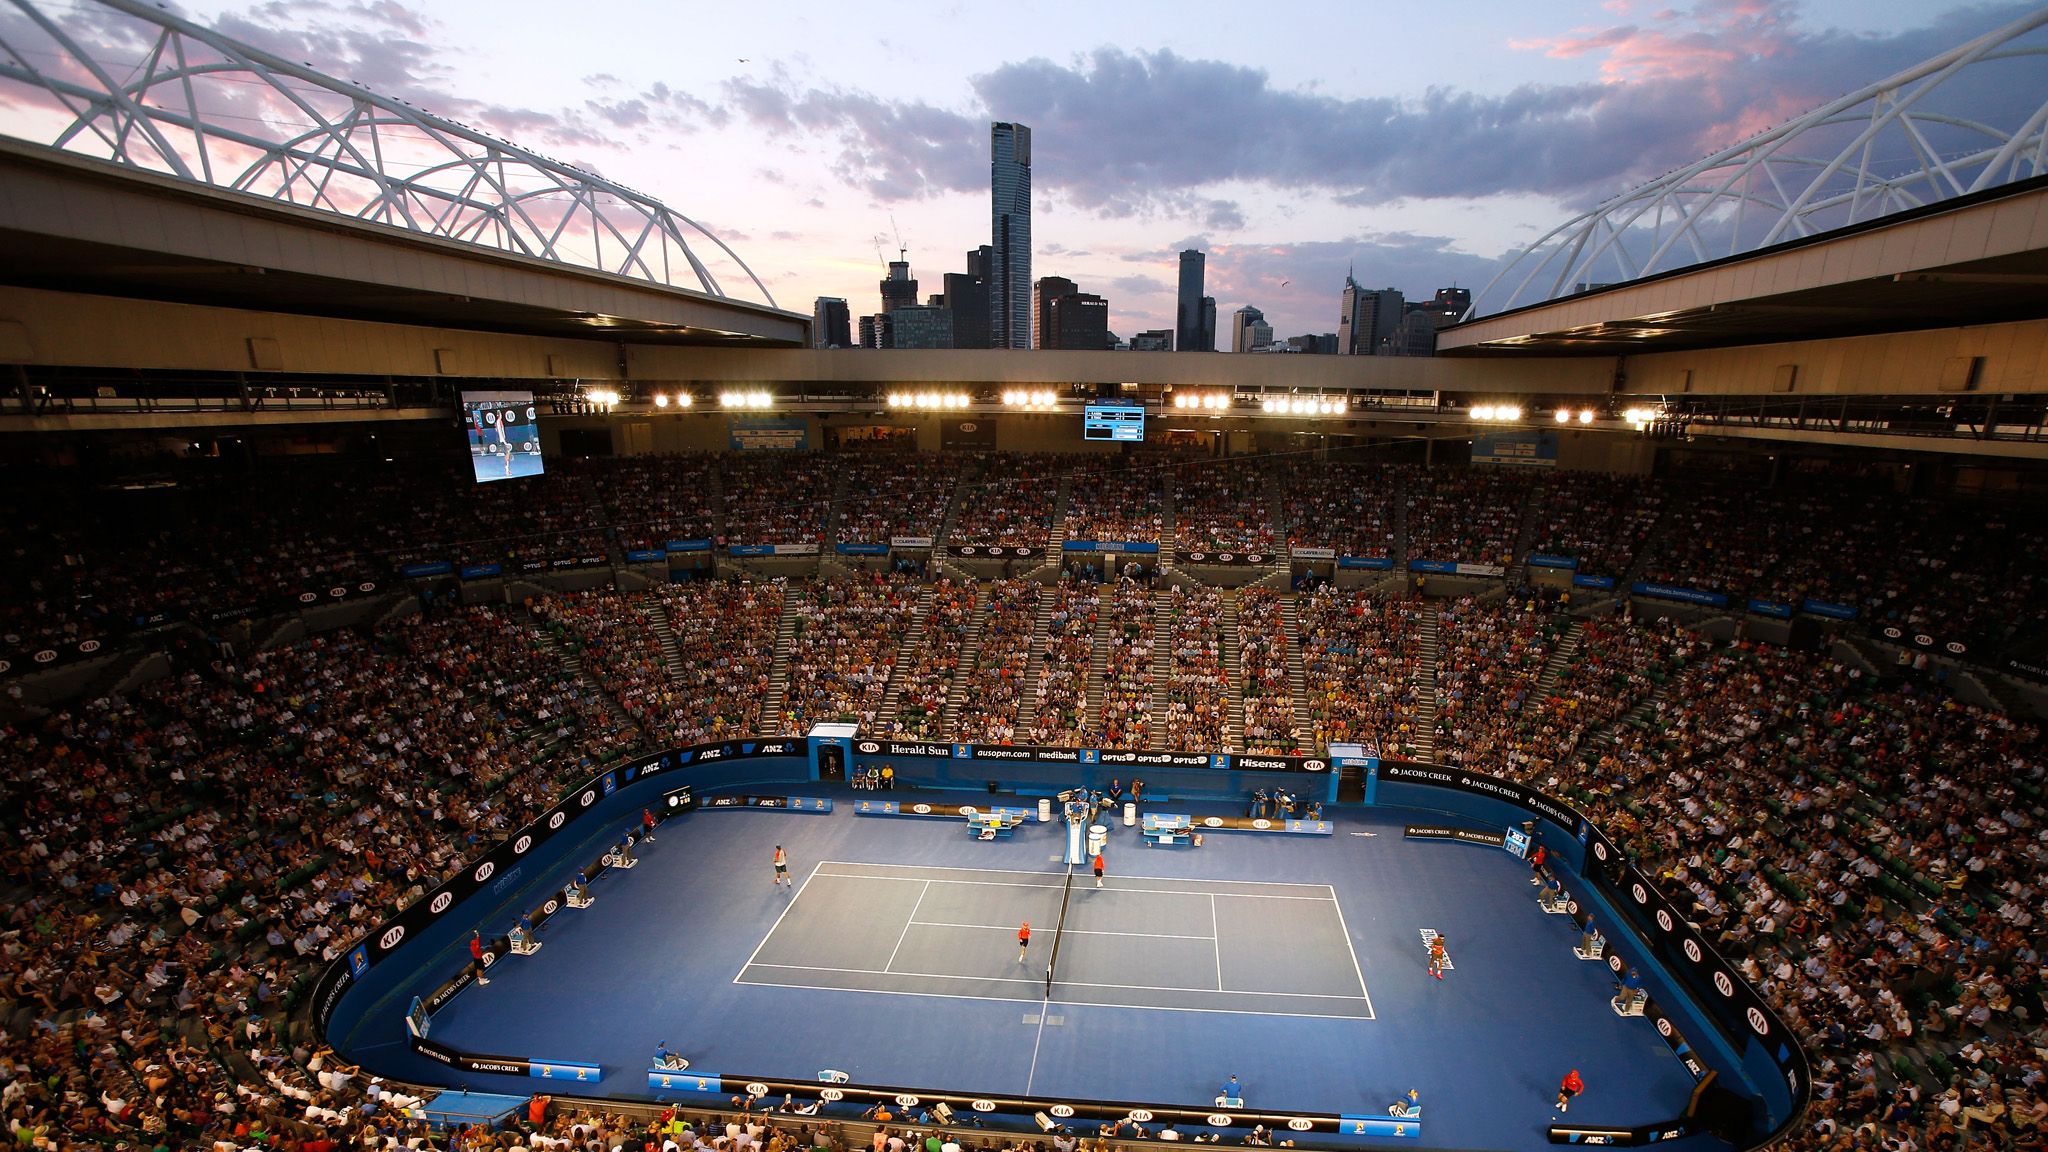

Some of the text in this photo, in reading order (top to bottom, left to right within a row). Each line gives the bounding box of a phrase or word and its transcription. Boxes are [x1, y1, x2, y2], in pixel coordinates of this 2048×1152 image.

[80, 641, 98, 651] KIA
[1916, 636, 1931, 644] KIA
[1948, 643, 1964, 652] KIA
[36, 651, 56, 661] KIA
[699, 749, 721, 760] ANZ
[762, 745, 783, 753] ANZ
[891, 744, 949, 755] Herald Sun
[977, 750, 1030, 758] ausopen.com
[1039, 751, 1077, 760] medibank
[641, 762, 660, 775] ANZ
[1239, 759, 1286, 769] Hisense
[1399, 768, 1452, 782] JACOB'S CREEK
[1470, 780, 1521, 800] JACOB'S CREEK
[582, 792, 594, 805] KIA
[551, 813, 563, 827] KIA
[1557, 812, 1574, 826] CREEK
[1511, 831, 1524, 842] 202
[516, 837, 530, 852] KIA
[1506, 842, 1522, 857] IBM
[1595, 843, 1605, 859] KIA
[602, 854, 612, 866] KIA
[477, 863, 492, 880] KIA
[1634, 885, 1645, 902] KIA
[432, 893, 450, 912] KIA
[544, 901, 556, 913] KIA
[1567, 902, 1576, 914] KIA
[1658, 911, 1670, 930] KIA
[382, 927, 403, 948] KIA
[1685, 940, 1699, 961] KIA
[482, 954, 494, 966] IA
[1610, 956, 1620, 970] KIA
[456, 973, 470, 987] CREEK
[1715, 972, 1731, 995] KIA
[1748, 1008, 1766, 1033] KIA
[1658, 1019, 1670, 1035] KIA
[1686, 1058, 1701, 1076] ANZ
[748, 1084, 767, 1093] KIA
[822, 1090, 841, 1099] KIA
[897, 1096, 917, 1105] KIA
[974, 1100, 994, 1110] KIA
[1052, 1106, 1072, 1115] KIA
[1130, 1110, 1151, 1120] KIA
[1210, 1115, 1230, 1124] KIA
[1290, 1119, 1311, 1128] KIA
[1584, 1136, 1604, 1144] ANZ
[1662, 1130, 1679, 1140] ANZ
